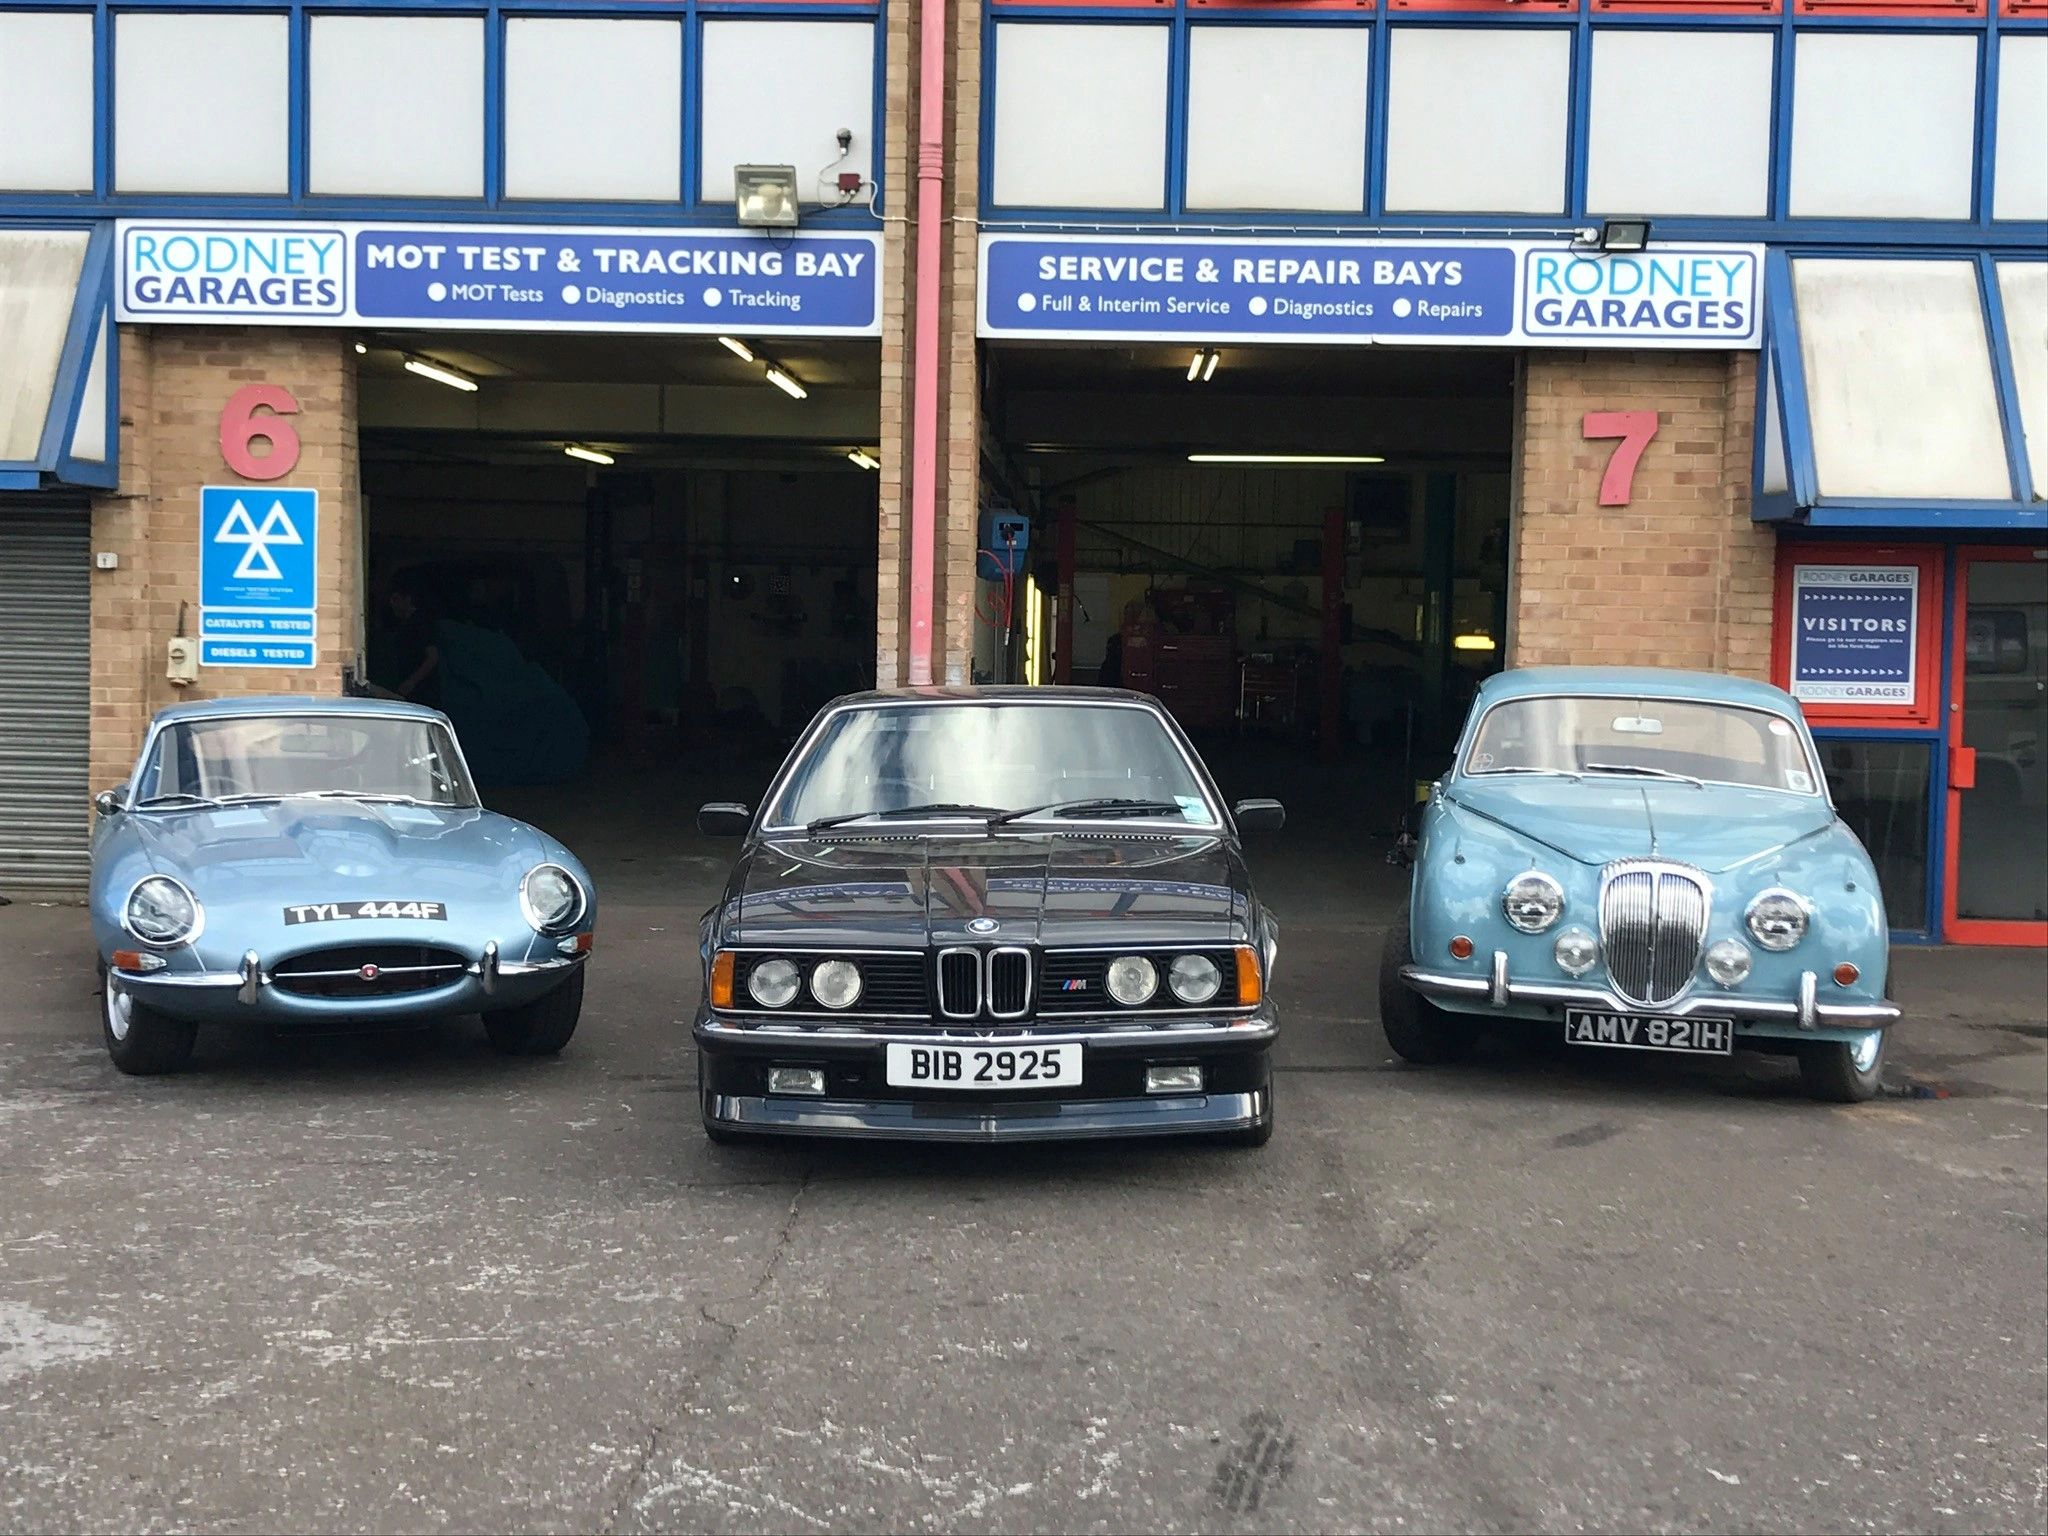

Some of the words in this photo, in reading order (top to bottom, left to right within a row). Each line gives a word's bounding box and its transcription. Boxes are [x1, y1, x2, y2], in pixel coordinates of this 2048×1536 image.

[135, 236, 336, 275] RODNEY
[367, 244, 446, 270] MOT
[456, 245, 547, 272] TEST
[556, 247, 581, 273] &
[593, 248, 782, 276] TRACKING
[795, 251, 865, 277] BAY
[1038, 256, 1184, 282] SERVICE
[1195, 258, 1219, 283] &
[1233, 259, 1361, 285] REPAIR
[1373, 260, 1462, 286] BAYS
[1535, 257, 1746, 297] RODNEY
[134, 275, 337, 307] GARAGES
[452, 284, 496, 301] MOT
[500, 284, 544, 303] Tests
[586, 286, 685, 308] Diagnostics
[728, 289, 801, 312] Tracking
[1042, 294, 1072, 312] Full
[1078, 295, 1092, 312] &
[1098, 296, 1161, 313] Interim
[1167, 296, 1230, 314] Service
[1273, 298, 1373, 320] Diagnostics
[1417, 300, 1483, 321] Repairs
[1534, 298, 1744, 329] GARAGES
[220, 384, 301, 480] 6
[1582, 411, 1658, 505] 7
[205, 618, 265, 629] CATALYSTS
[269, 619, 311, 630] TESTED
[1803, 617, 1907, 632] VISITORS
[210, 647, 257, 658] DIESELS
[262, 648, 305, 659] TESTED
[289, 903, 352, 923] TYL
[357, 901, 439, 919] 444F
[1575, 1014, 1639, 1044] AMV
[1648, 1019, 1724, 1049] 821H
[911, 1048, 962, 1081] BIB
[973, 1049, 1061, 1082] 2925
